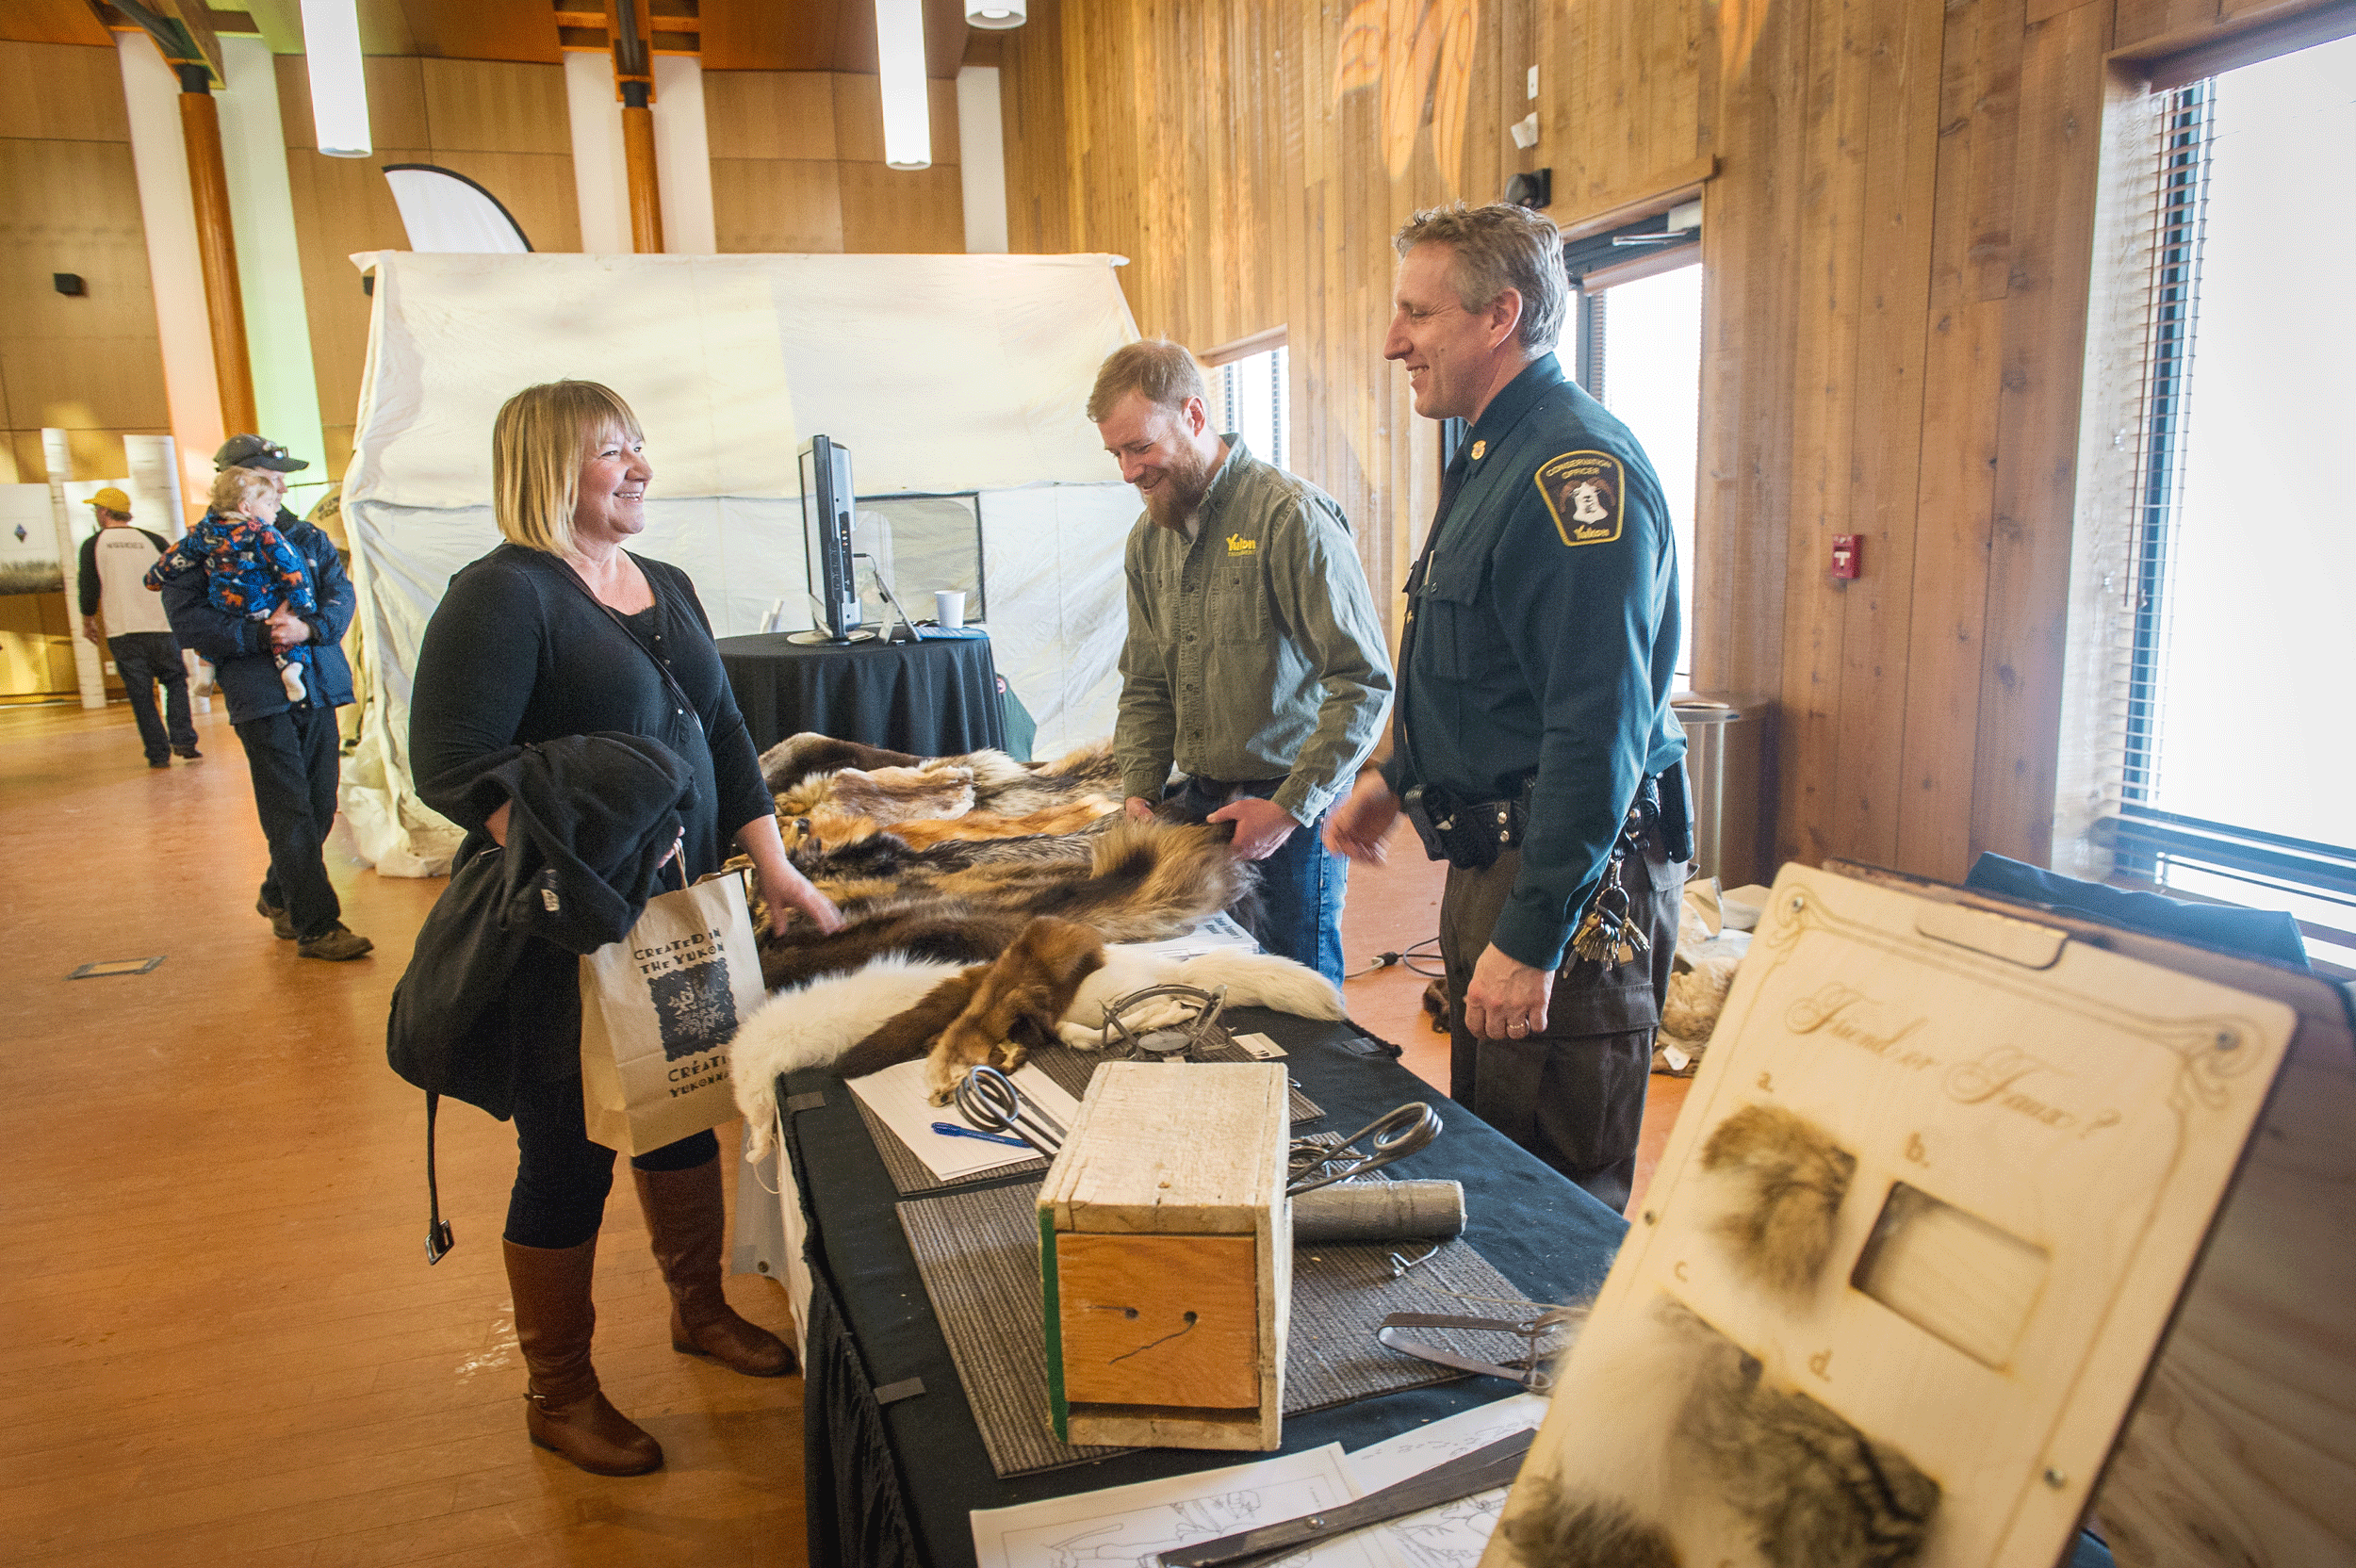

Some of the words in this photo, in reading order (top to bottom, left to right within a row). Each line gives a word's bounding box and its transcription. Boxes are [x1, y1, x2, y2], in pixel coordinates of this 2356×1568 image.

[1546, 458, 1612, 477] CONSERVATION
[1562, 467, 1600, 480] OFFICER
[1573, 524, 1610, 540] Yukon
[1226, 533, 1256, 551] Yukon
[634, 933, 705, 960] CREATED
[708, 927, 721, 939] IN
[639, 961, 669, 974] THE
[673, 942, 725, 965] YUKON
[668, 1055, 731, 1082] CRÉATI
